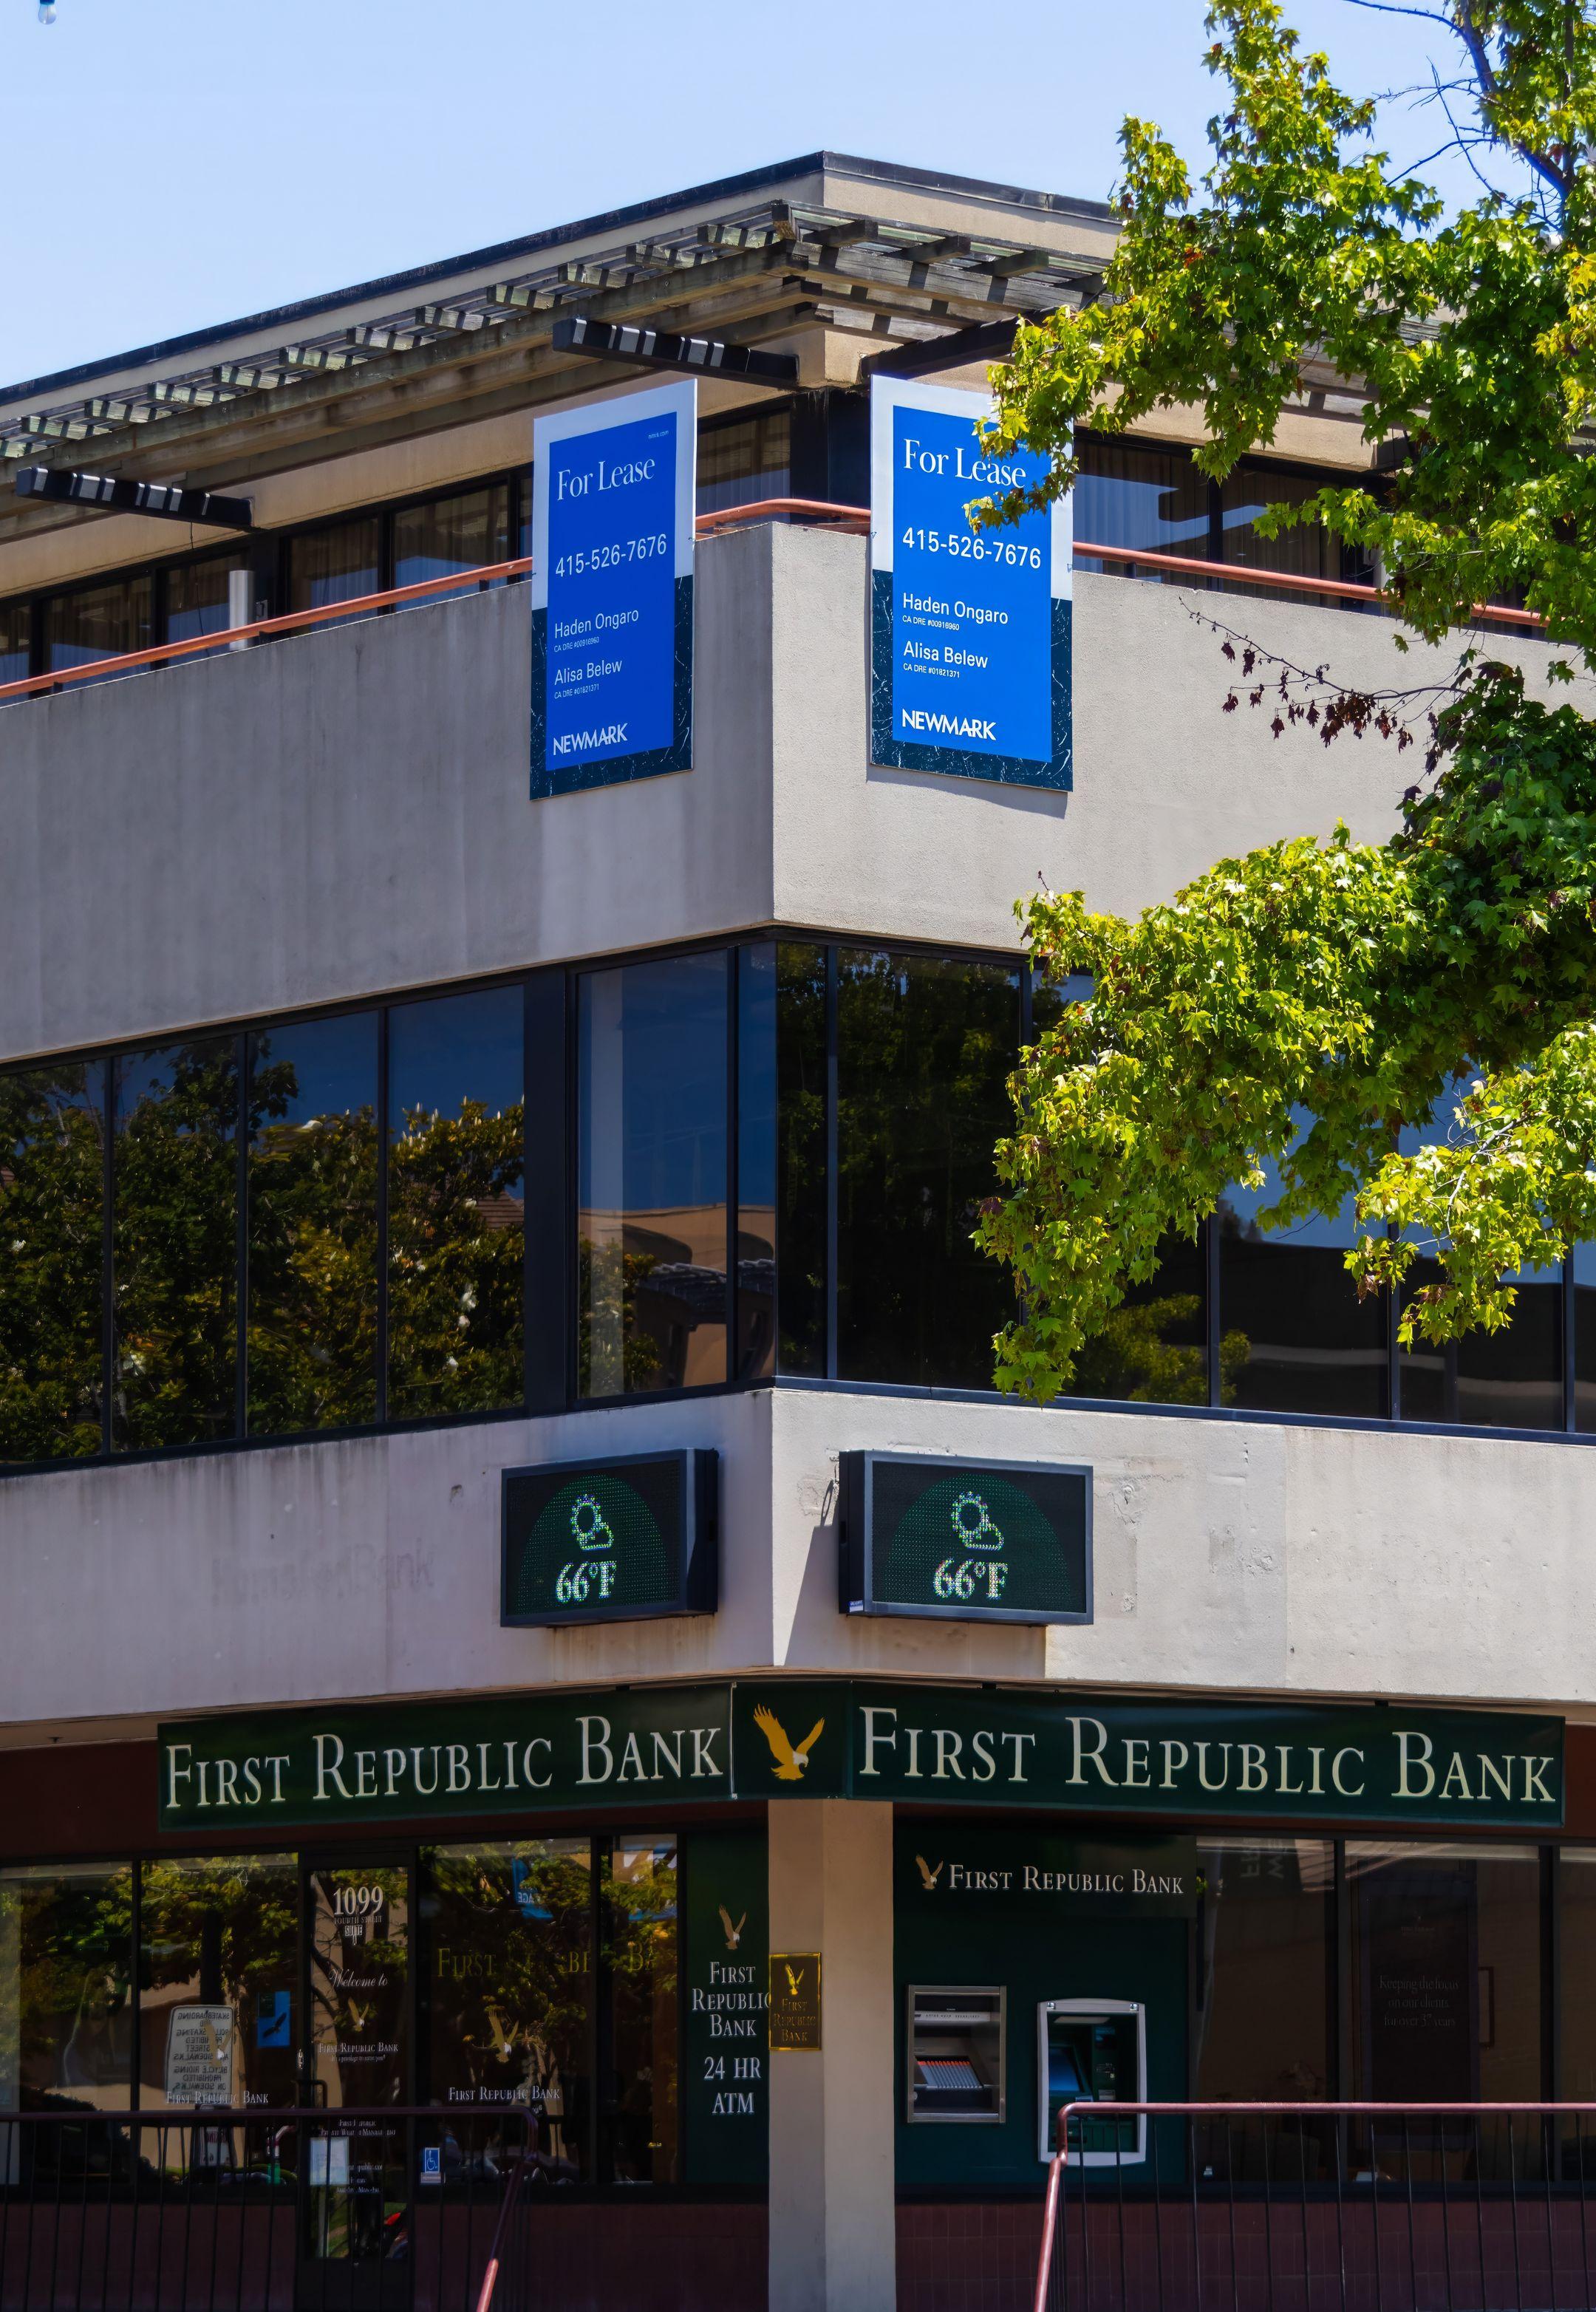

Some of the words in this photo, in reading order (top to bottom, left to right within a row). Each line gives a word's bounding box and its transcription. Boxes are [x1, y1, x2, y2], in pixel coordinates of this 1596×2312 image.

[904, 438, 949, 475] For
[955, 447, 1026, 488] Lease
[557, 469, 593, 501] For
[598, 458, 655, 491] Lease
[556, 533, 666, 577] 415-526-7676
[902, 527, 1041, 569] 415-526-7676
[902, 615, 912, 623] CA
[913, 616, 926, 625] DRE
[903, 593, 949, 615] Haden
[954, 601, 1009, 624] Ongaro
[554, 618, 591, 638] Haden
[595, 610, 639, 630] Ongaro
[562, 642, 573, 650] DRE
[903, 641, 939, 661] Alisa
[944, 647, 988, 669] Belew
[554, 667, 582, 686] Alisa
[587, 660, 622, 679] Belew
[903, 663, 913, 671] CA
[913, 664, 927, 673] DRE
[562, 689, 573, 698] DRE
[902, 708, 997, 741] NEWMARK
[553, 723, 628, 756] NEWMARK
[555, 1560, 617, 1603] 66°F
[932, 1558, 1009, 1600] 66°F
[333, 1886, 383, 1915] 1099
[329, 1968, 375, 1988] Welcome
[378, 1973, 388, 1987] to
[703, 2056, 726, 2080] 24
[734, 2056, 762, 2079] HR
[712, 2093, 755, 2114] ATM
